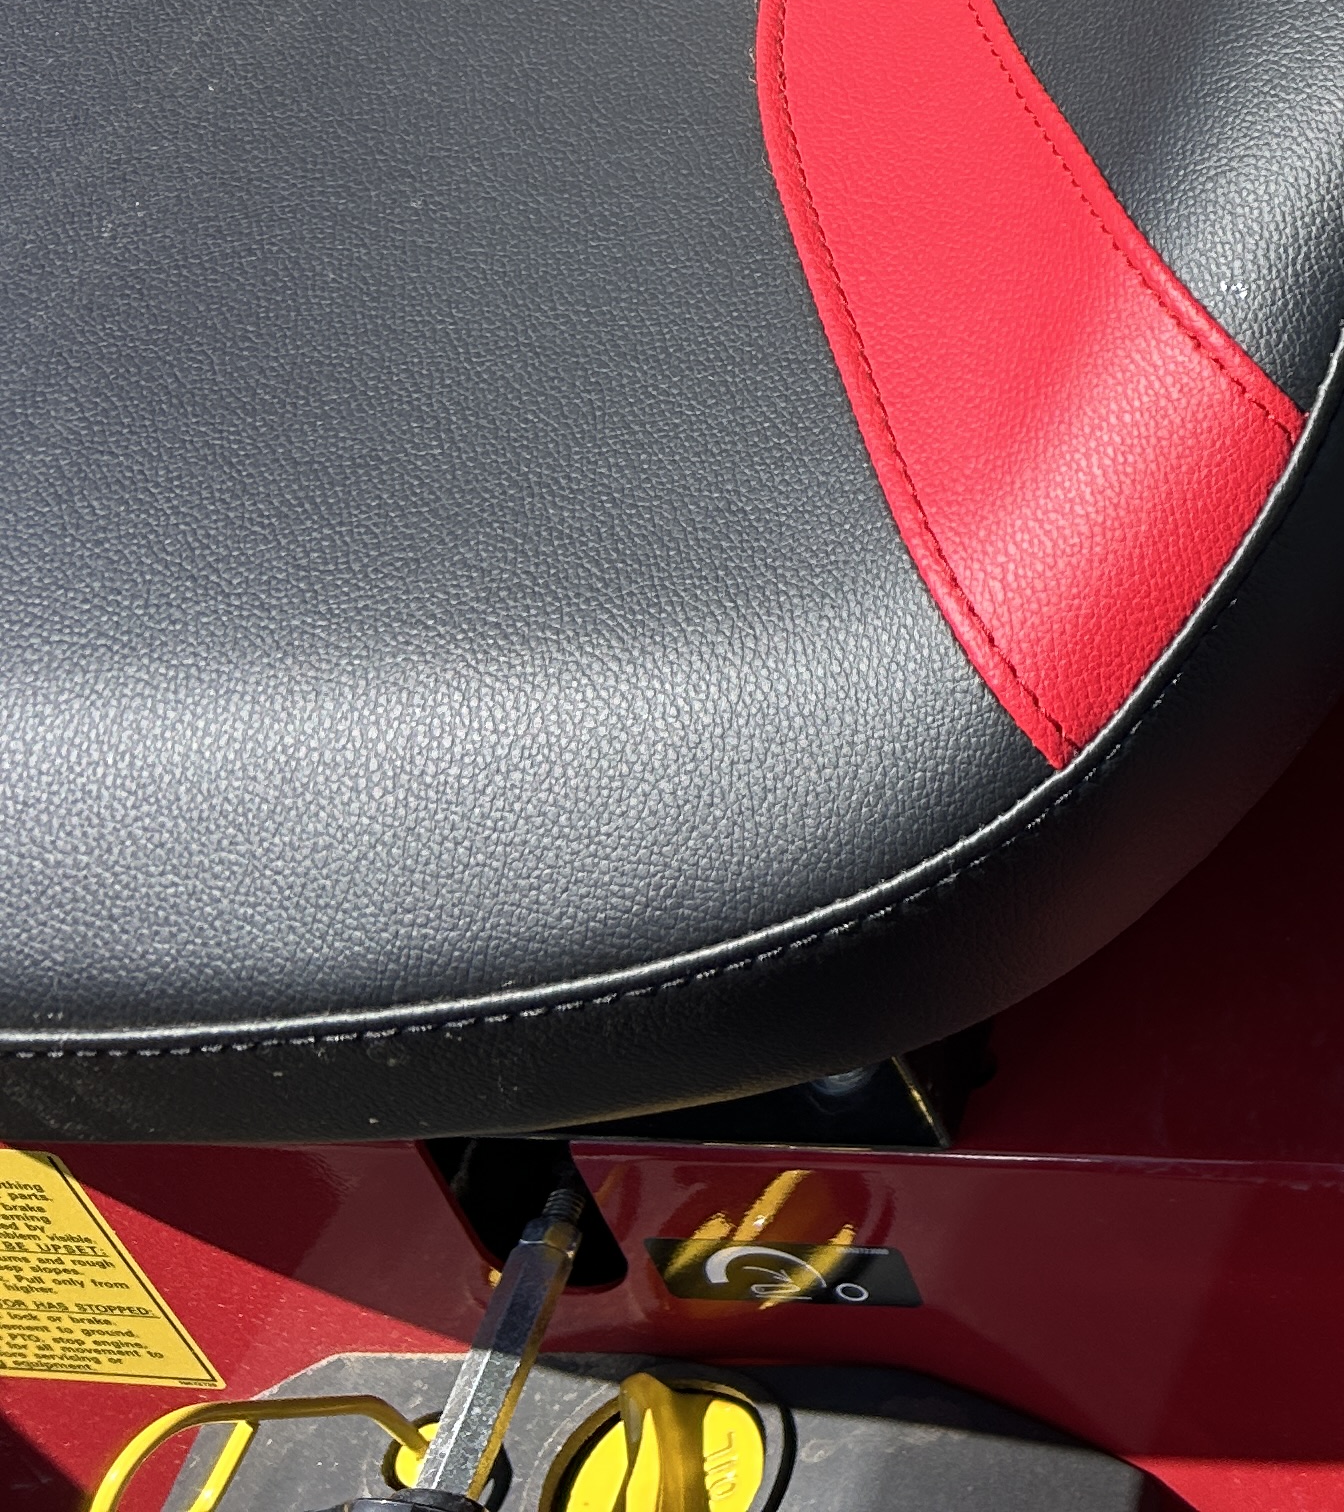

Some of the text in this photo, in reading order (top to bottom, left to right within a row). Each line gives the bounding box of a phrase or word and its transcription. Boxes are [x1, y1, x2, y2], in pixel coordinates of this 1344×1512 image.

[0, 1180, 45, 1193] thing
[0, 1202, 47, 1213] brake
[24, 1222, 45, 1234] by
[37, 1256, 65, 1265] and
[71, 1259, 116, 1269] rough
[52, 1277, 84, 1289] only
[32, 1300, 69, 1312] HAS
[56, 1326, 74, 1335] to
[52, 1336, 86, 1347] stop
[5, 1341, 165, 1359] for all movement to
[108, 1357, 123, 1365] or
